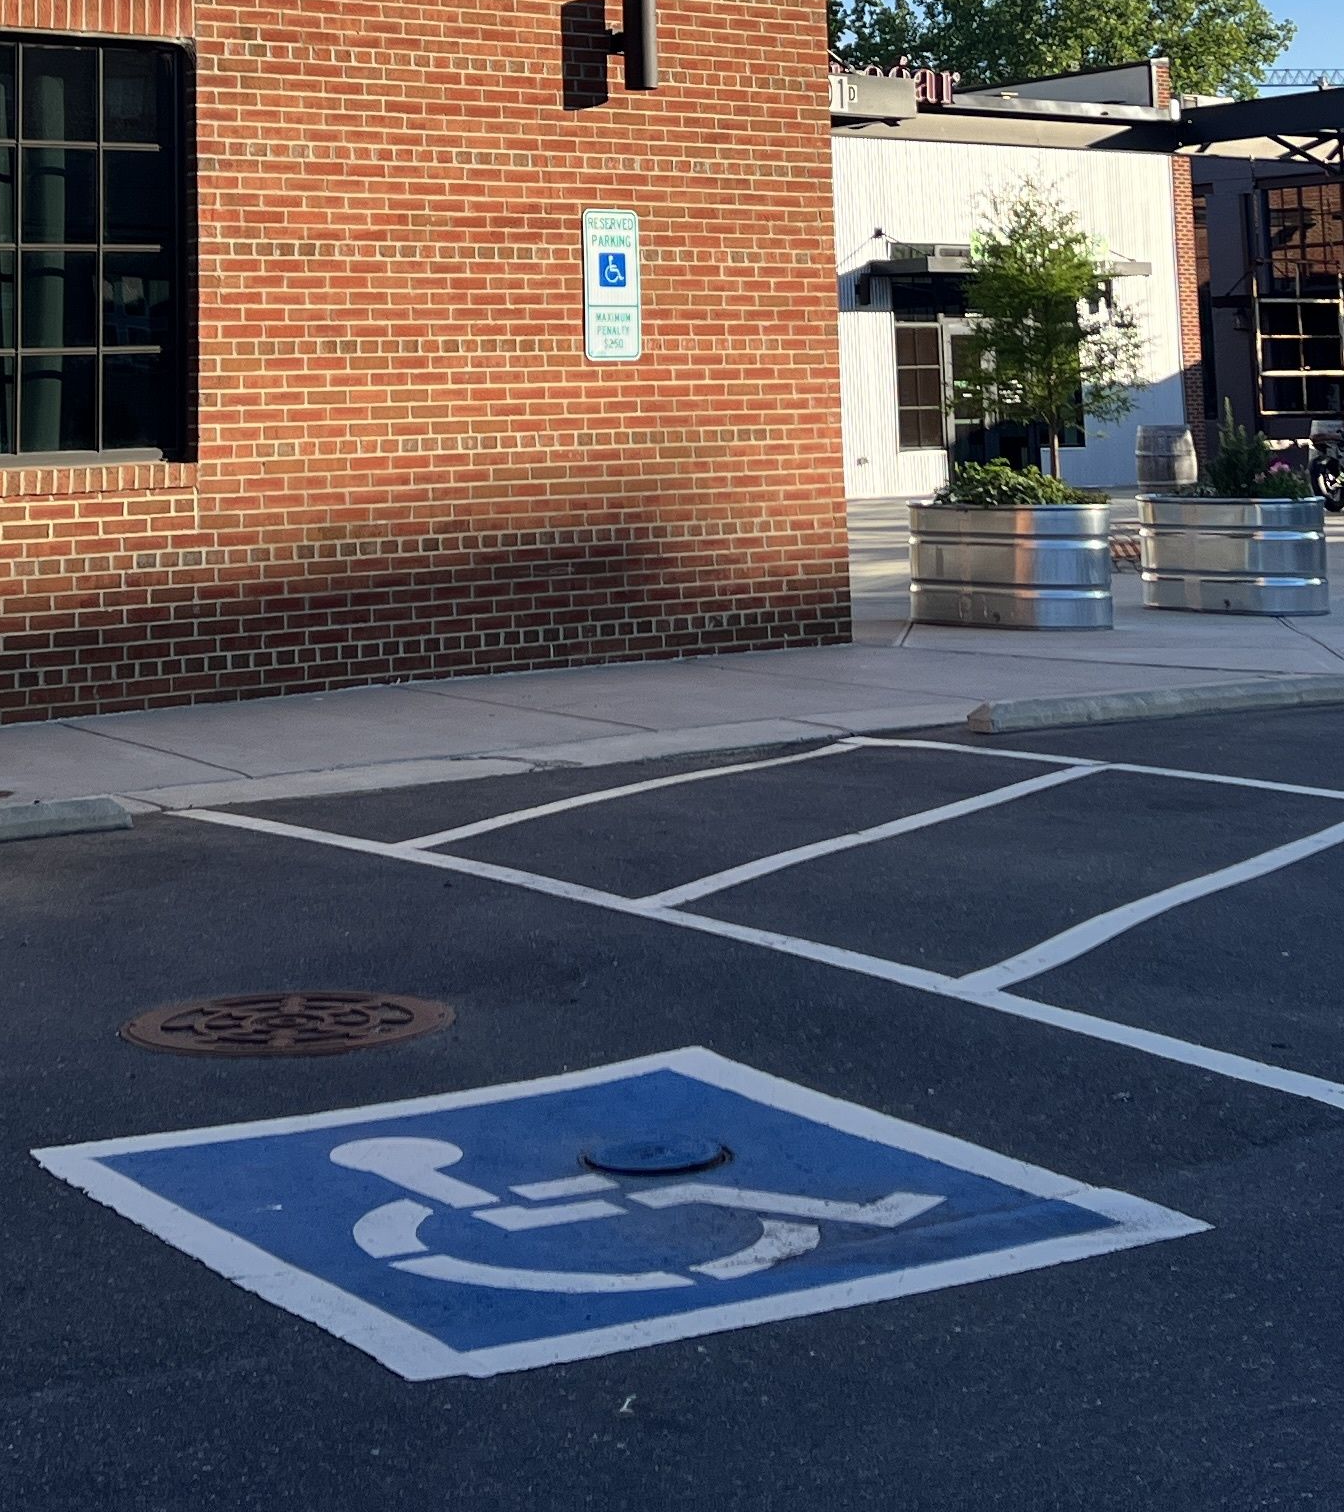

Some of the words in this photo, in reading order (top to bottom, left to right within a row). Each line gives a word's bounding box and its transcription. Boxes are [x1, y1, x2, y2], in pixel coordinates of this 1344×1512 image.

[588, 218, 633, 230] RESERVED
[592, 234, 631, 247] PARKING
[596, 313, 631, 322] MAXIMUM
[597, 326, 629, 335] PENALTY
